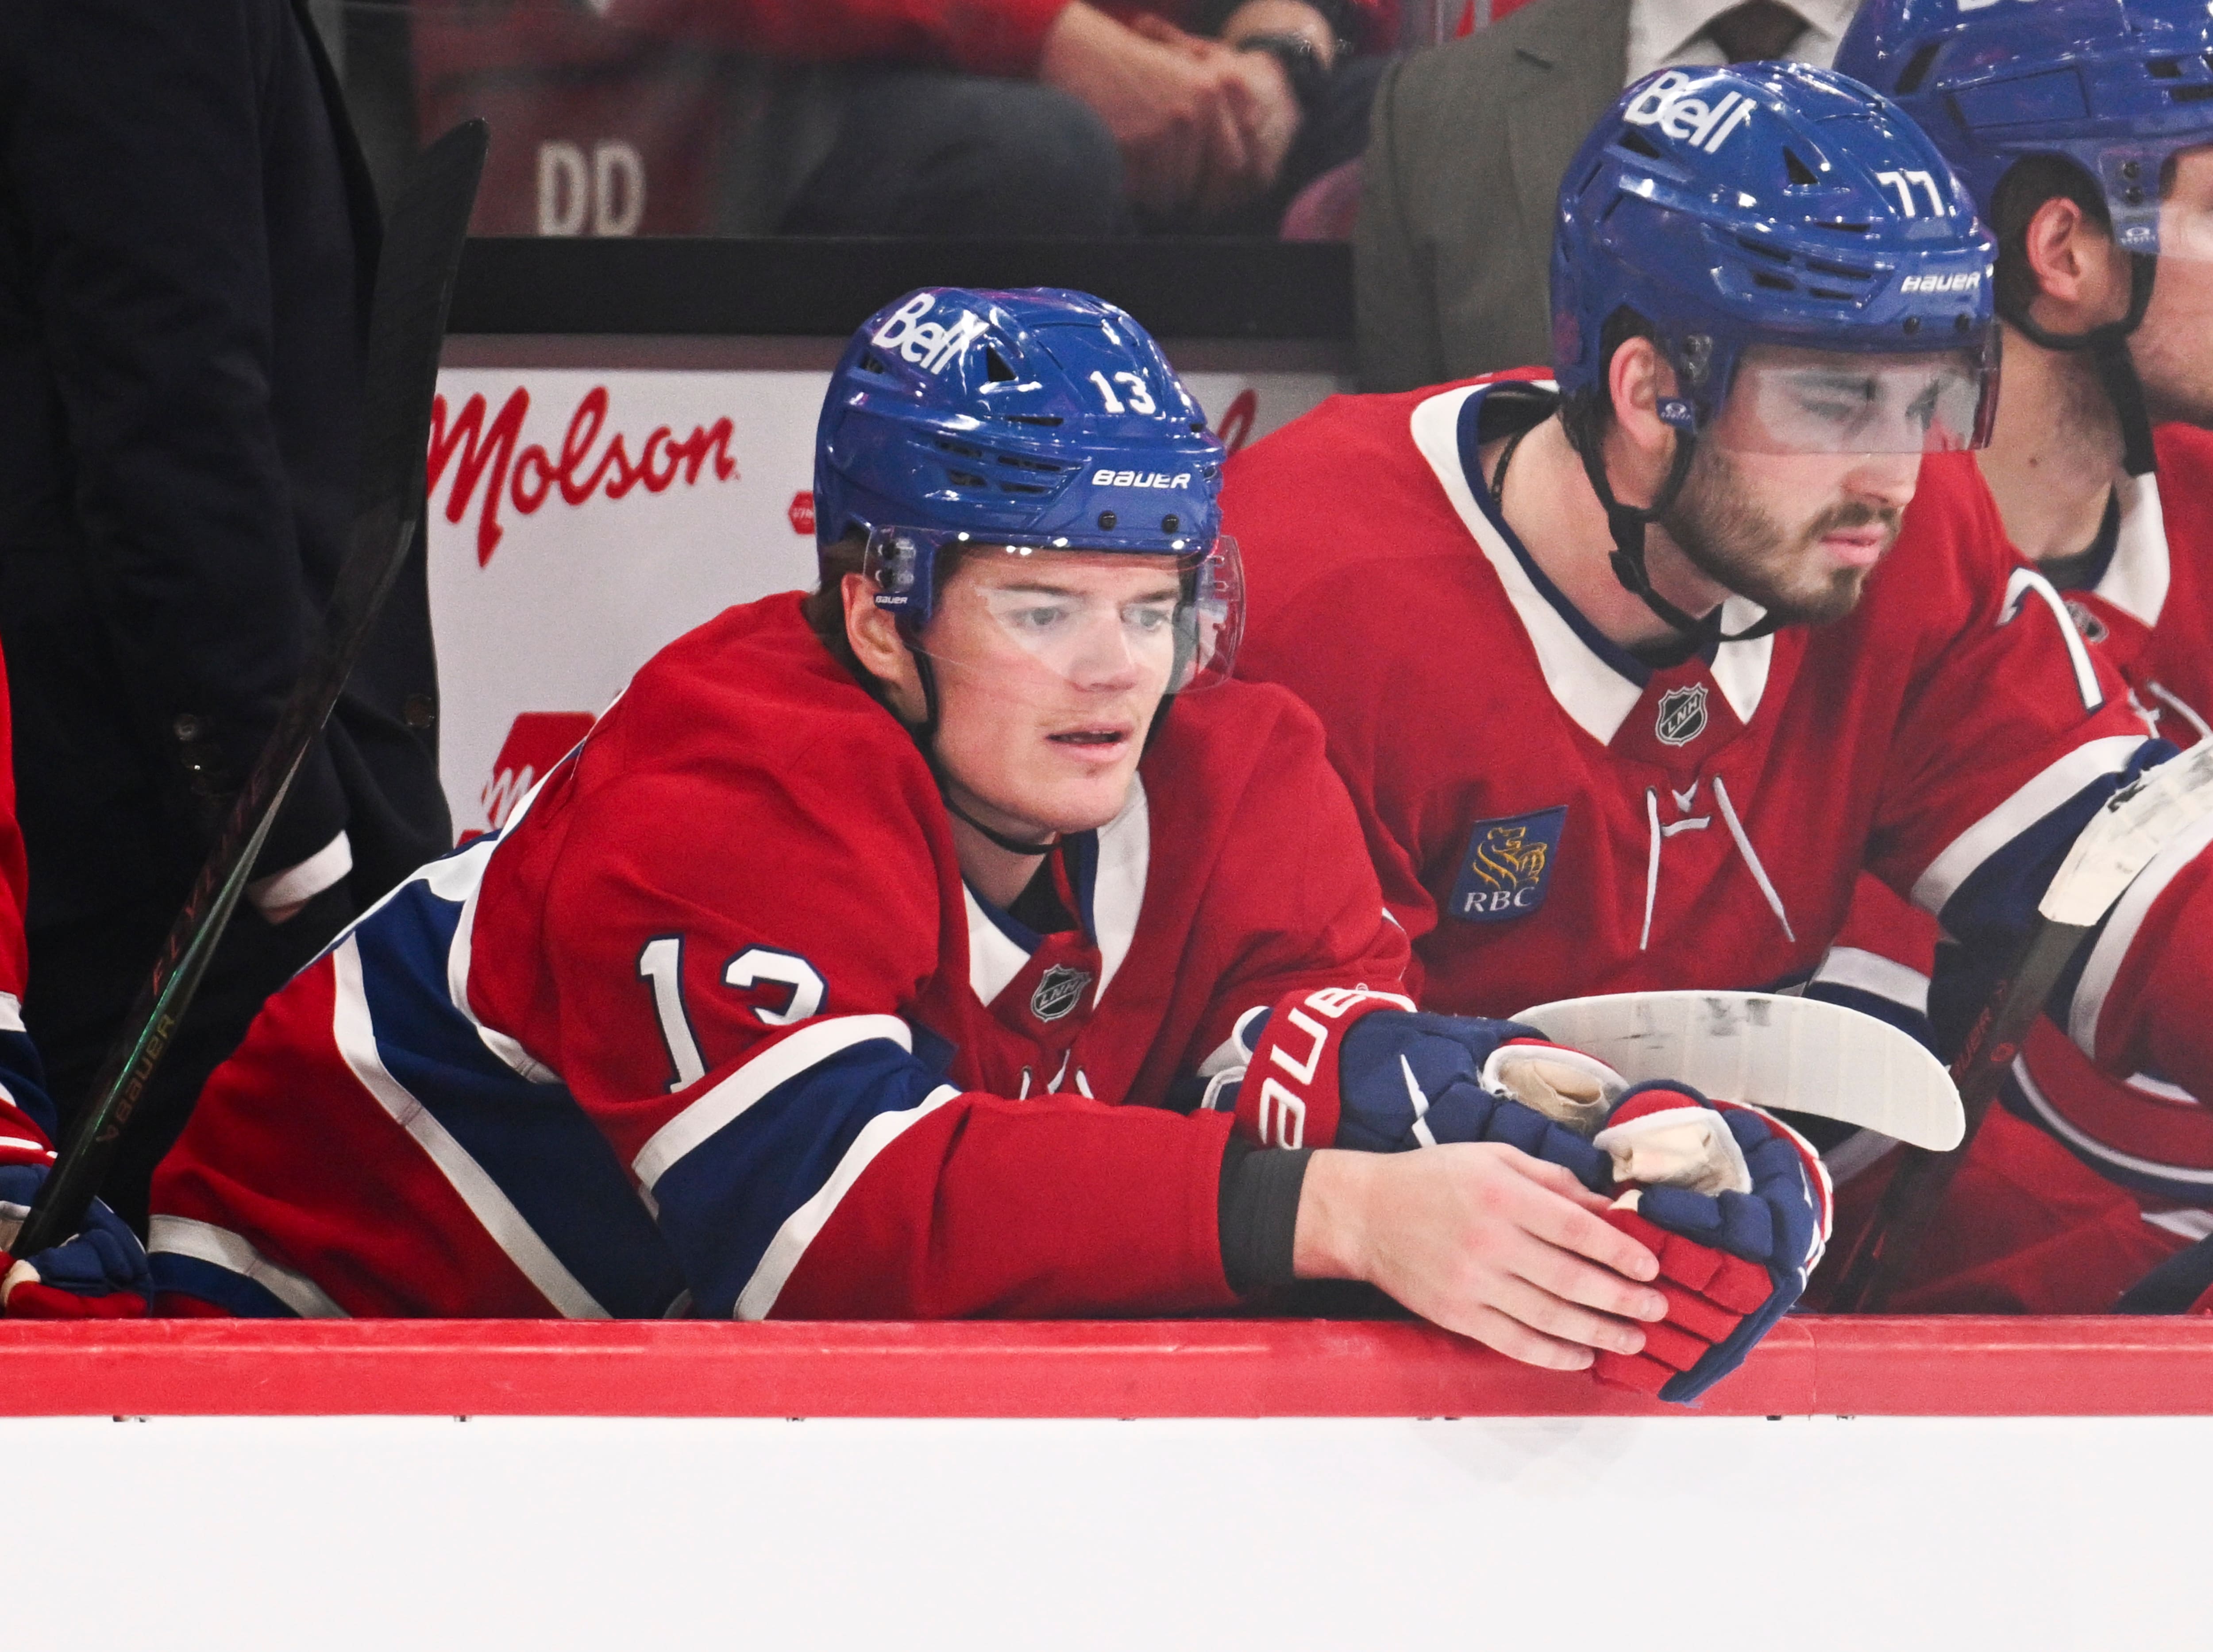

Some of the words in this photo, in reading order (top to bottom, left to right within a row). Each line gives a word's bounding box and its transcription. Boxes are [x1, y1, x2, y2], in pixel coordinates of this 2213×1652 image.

[1623, 70, 1758, 153] Bell
[1876, 170, 1944, 218] 77
[872, 293, 990, 374] Bell
[1089, 371, 1156, 414] 13
[427, 385, 735, 569] Molson
[1092, 469, 1191, 489] BAUER
[1668, 695, 1698, 734] LNH
[1464, 886, 1535, 912] RBC
[116, 1014, 175, 1123] BAUER
